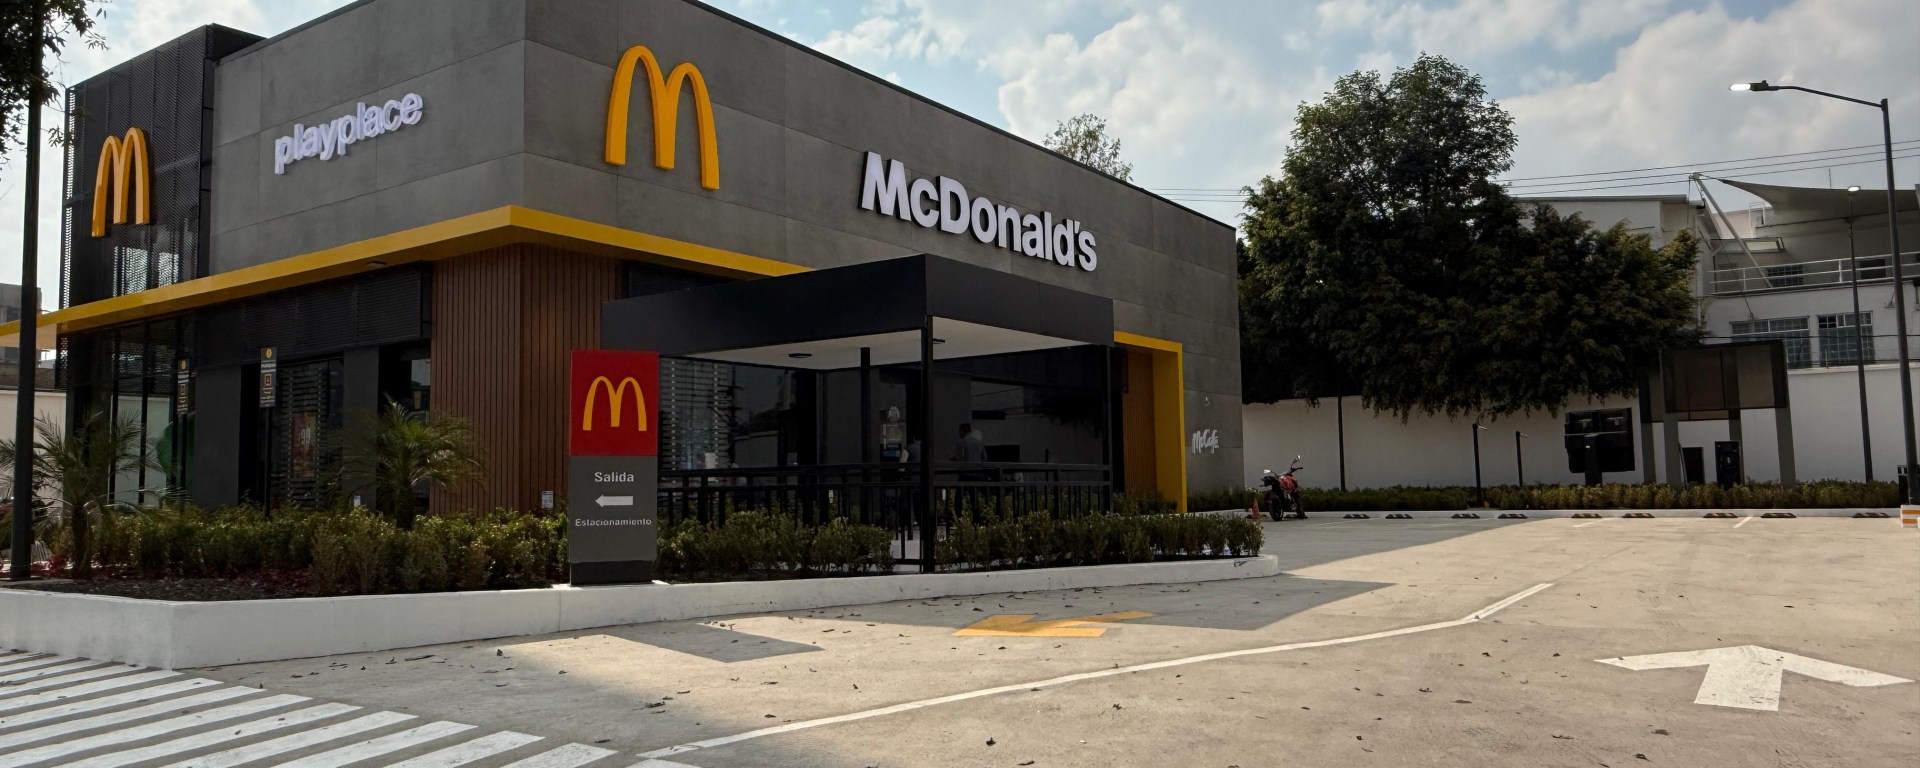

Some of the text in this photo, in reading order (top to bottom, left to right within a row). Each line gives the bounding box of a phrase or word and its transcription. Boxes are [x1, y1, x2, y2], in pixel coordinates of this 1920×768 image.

[275, 92, 424, 175] playplace
[859, 151, 1099, 273] McDonald's
[594, 471, 635, 483] Salida
[575, 518, 652, 527] Estacionamiento
